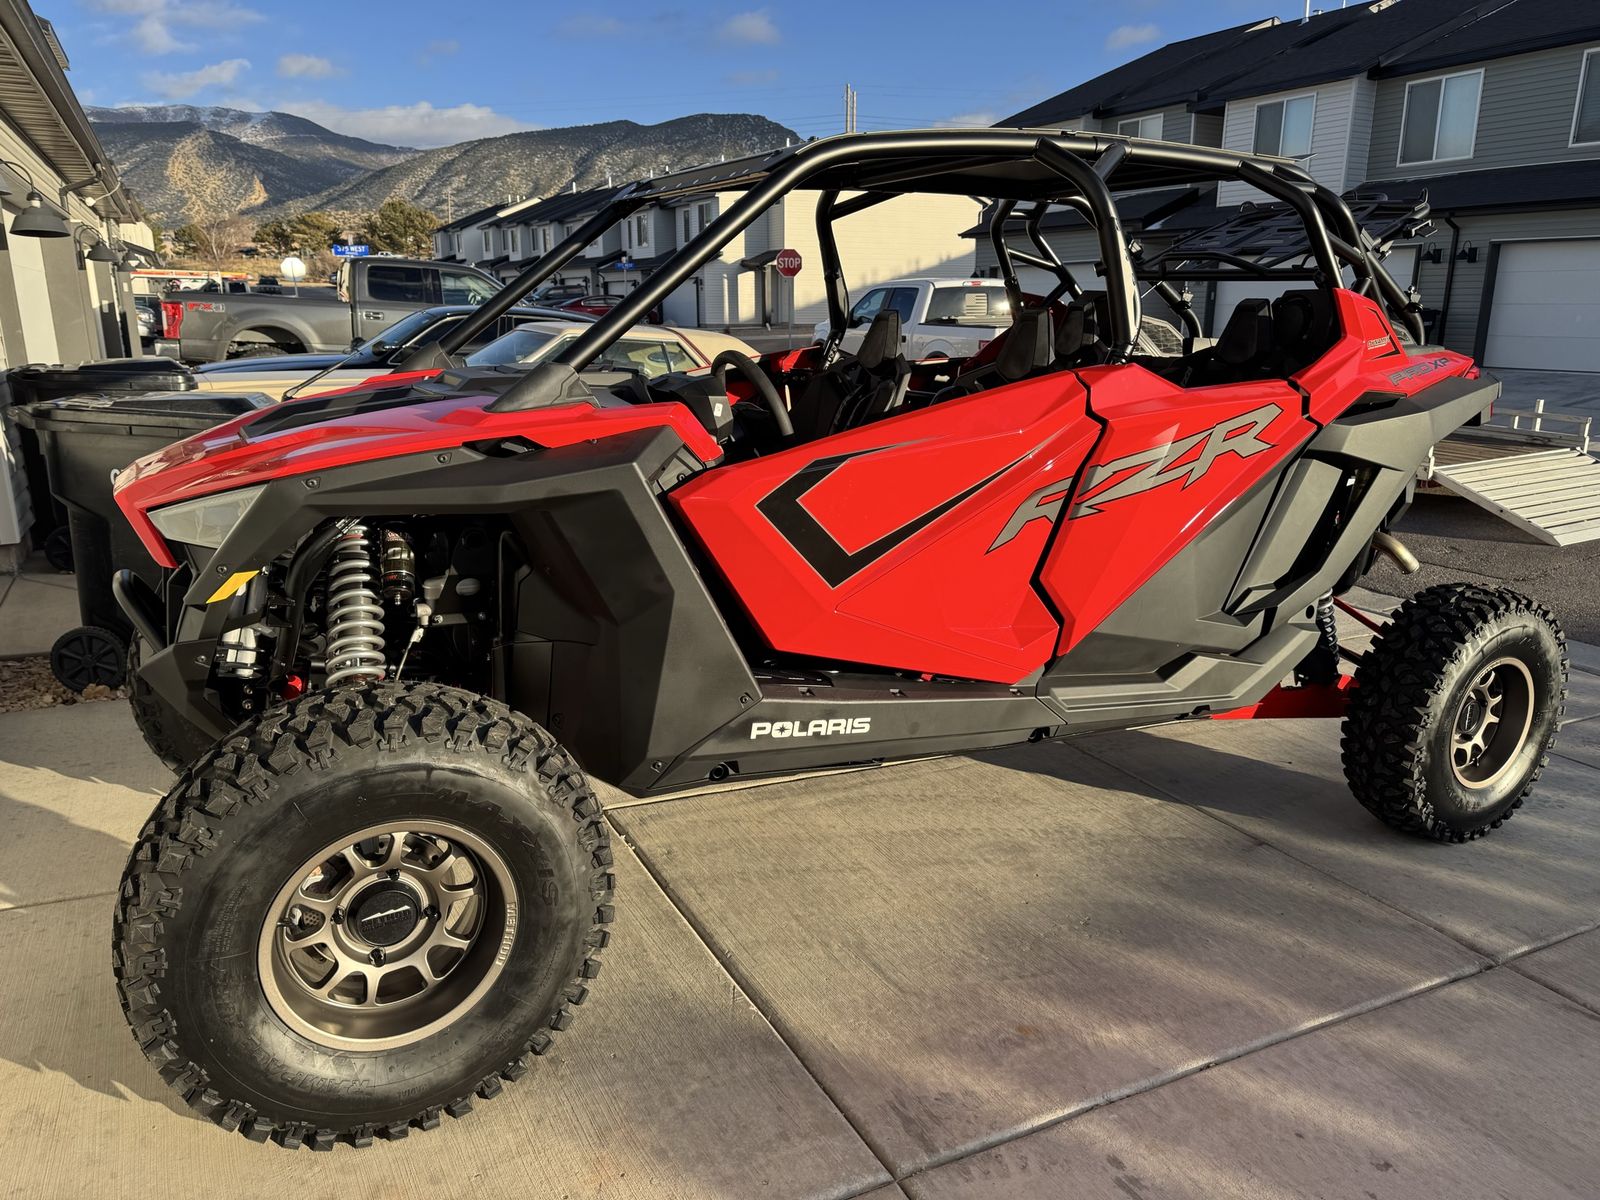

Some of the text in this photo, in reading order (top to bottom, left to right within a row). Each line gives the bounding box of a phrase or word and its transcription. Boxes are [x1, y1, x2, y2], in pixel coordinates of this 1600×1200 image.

[778, 257, 801, 269] STOP
[1388, 357, 1450, 386] PRO XP
[985, 402, 1284, 555] RZR
[750, 717, 871, 740] POLARIS
